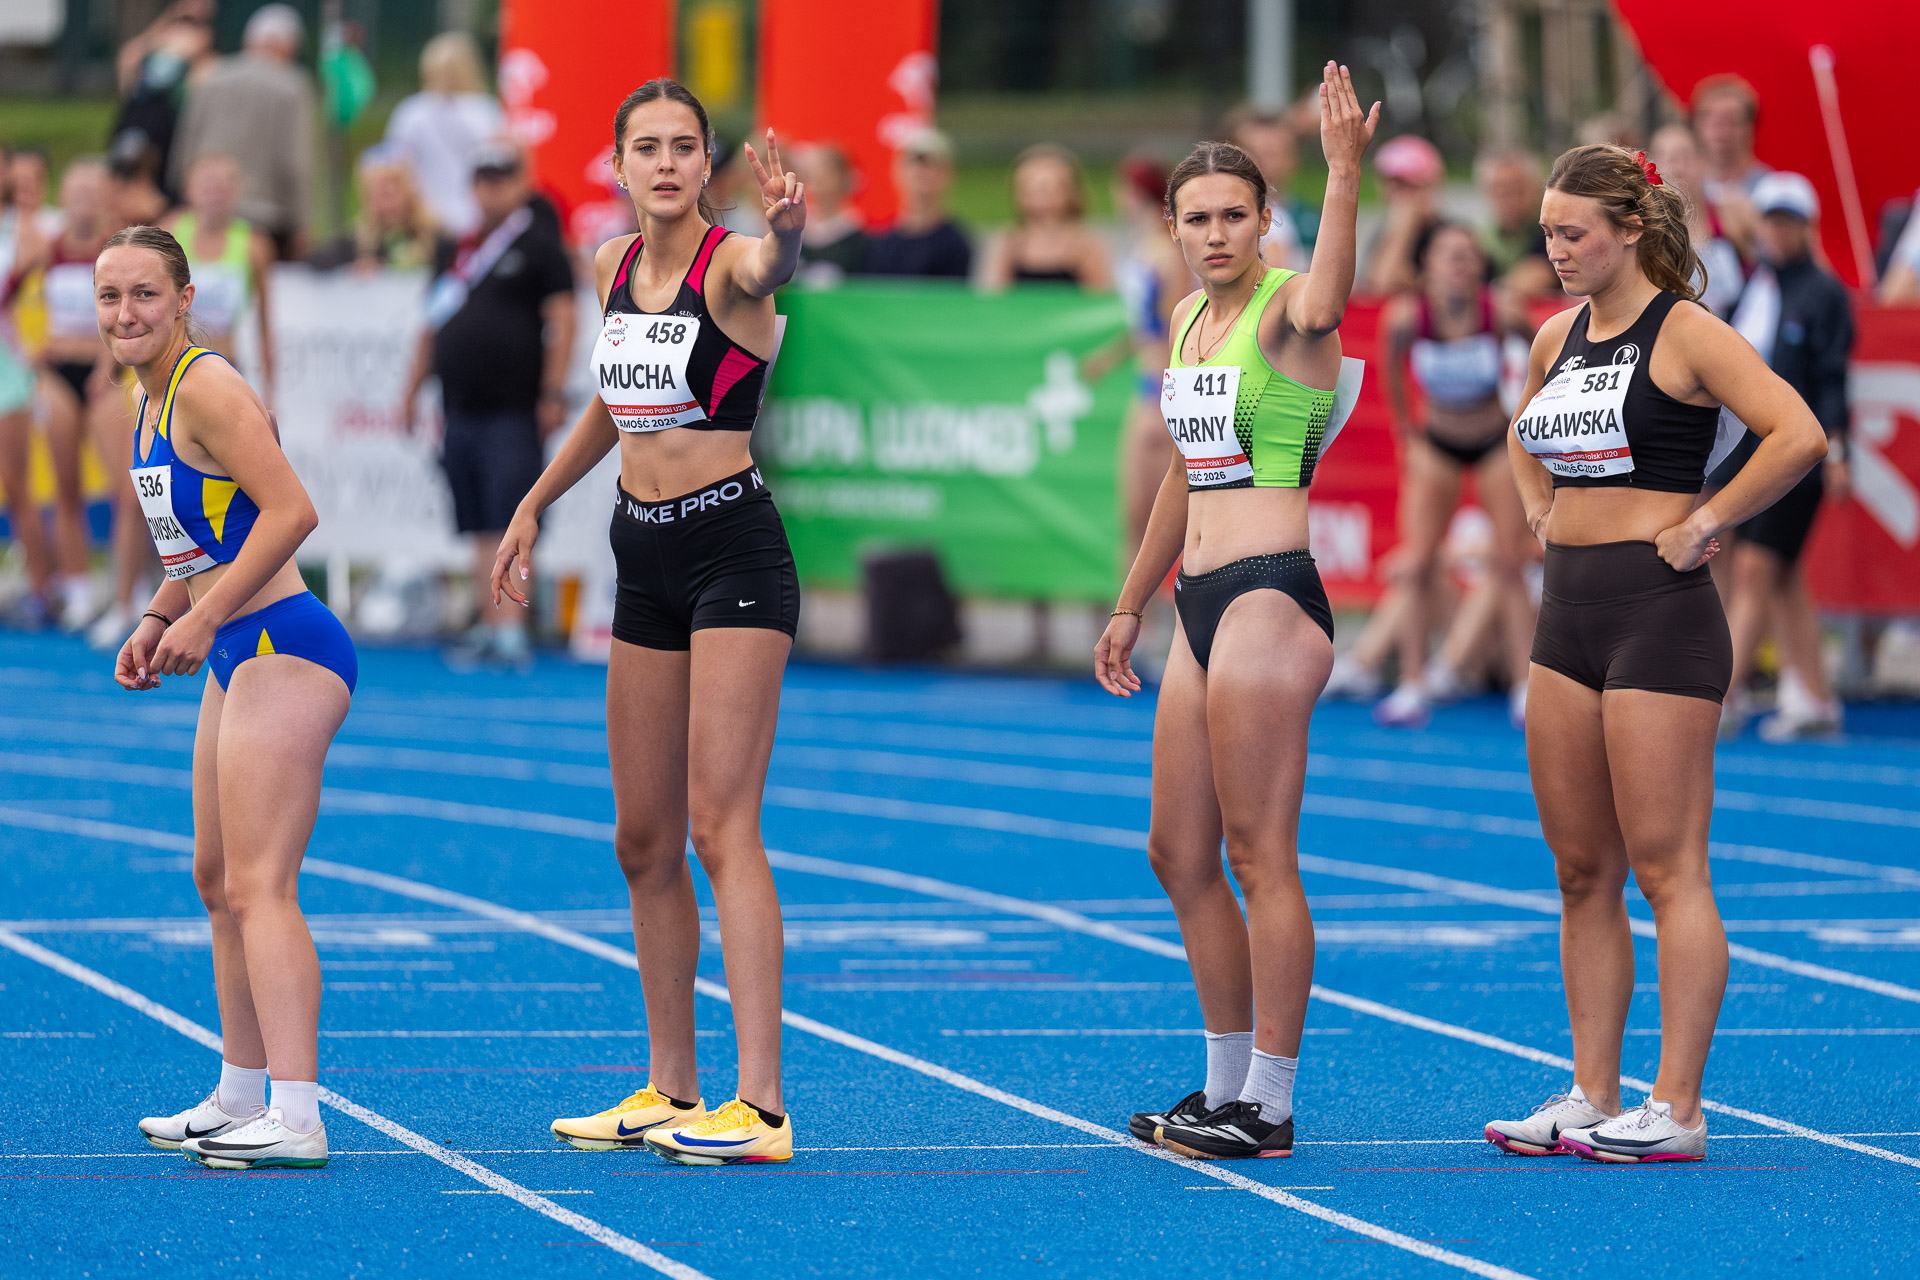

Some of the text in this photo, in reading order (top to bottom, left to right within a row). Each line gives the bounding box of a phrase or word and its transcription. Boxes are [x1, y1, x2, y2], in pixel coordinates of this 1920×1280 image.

[646, 322, 687, 344] 458
[599, 363, 677, 390] MUCHA
[1193, 373, 1227, 396] 411
[1581, 371, 1620, 394] 581
[654, 406, 673, 414] Polski
[651, 417, 678, 428] 2026
[1517, 408, 1620, 441] PUŁAWSKA
[1206, 459, 1223, 467] Polski
[1222, 457, 1236, 466] U20
[1603, 450, 1618, 458] U20
[1203, 471, 1227, 482] 2026
[1553, 462, 1606, 474] ZAMOŚĆ 2026
[138, 473, 164, 498] 536
[627, 499, 675, 524] NIKE
[681, 481, 743, 519] PRO
[175, 564, 196, 577] 2026
